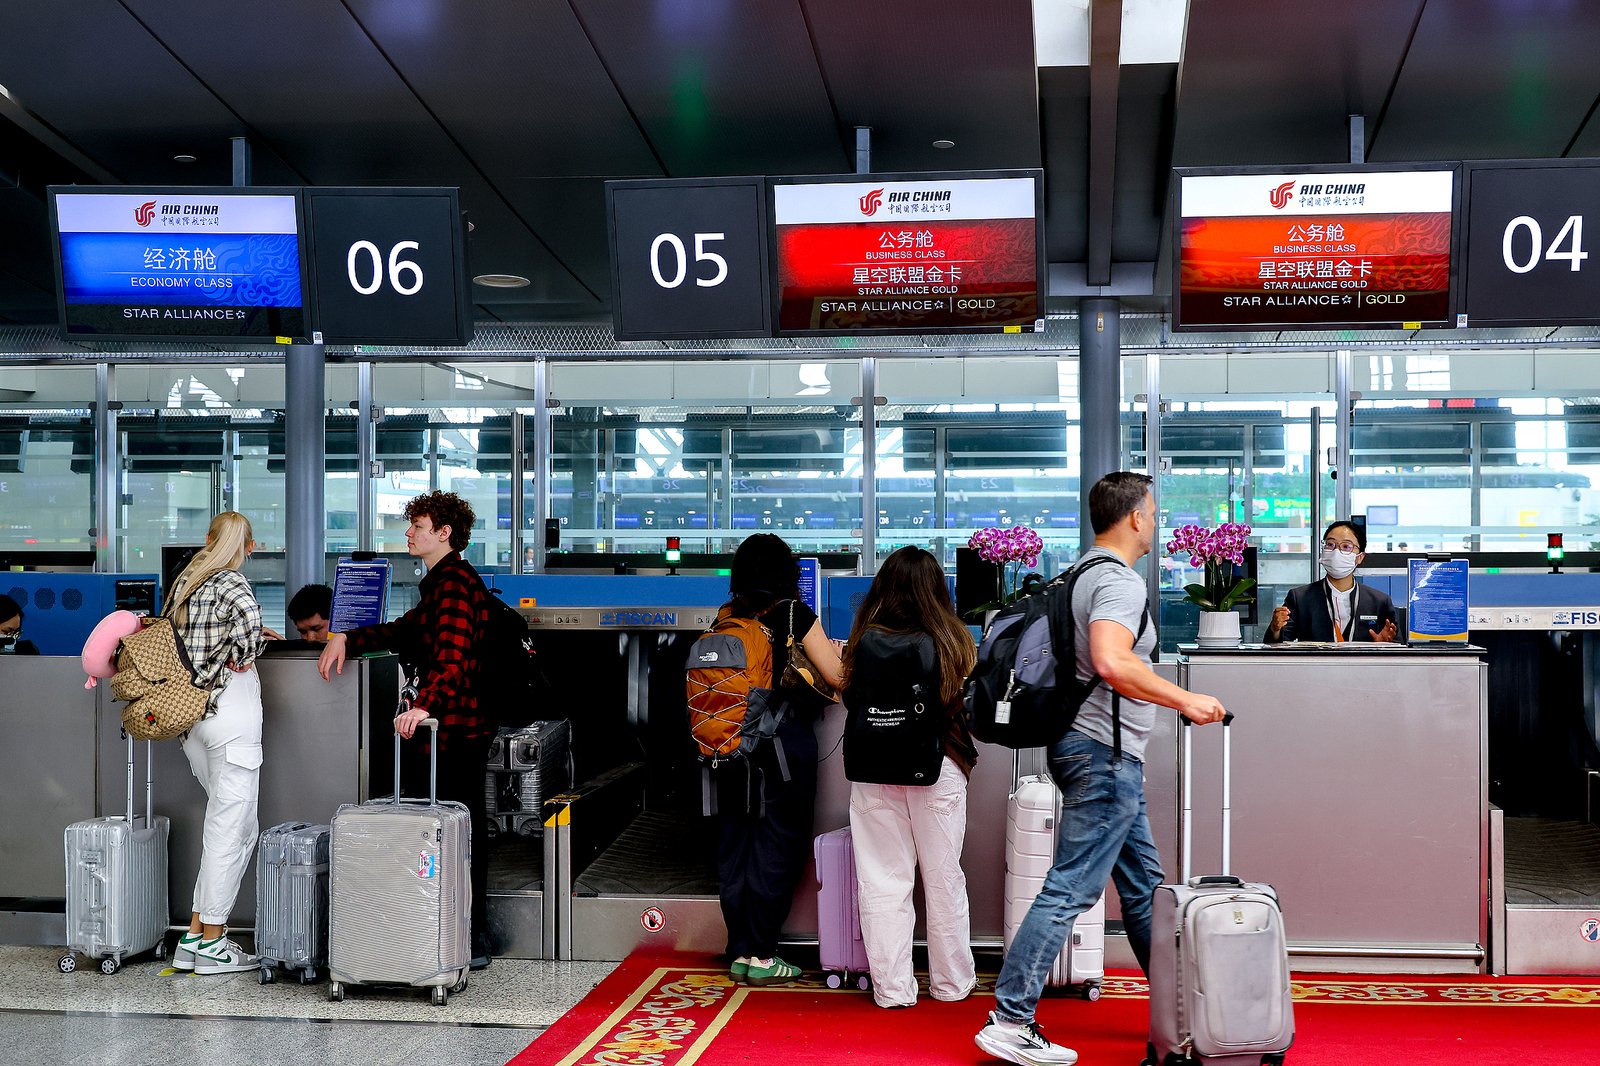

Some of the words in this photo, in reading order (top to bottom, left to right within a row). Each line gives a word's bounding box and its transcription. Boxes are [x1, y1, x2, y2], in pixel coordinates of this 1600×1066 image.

[1300, 184, 1323, 195] AIR
[1325, 183, 1366, 194] CHINA
[888, 191, 910, 202] AIR
[912, 190, 952, 202] CHINA
[161, 204, 181, 215] AIR
[183, 204, 219, 215] CHINA
[1287, 223, 1345, 243] 公务舱
[878, 230, 935, 249] 公务舱
[1502, 215, 1589, 273] 04
[865, 250, 912, 260] BUSINESS
[914, 249, 946, 259] CLASS
[1273, 244, 1321, 254] BUSINESS
[1324, 244, 1356, 253] CLASS
[143, 246, 217, 271] 经济舱
[649, 232, 729, 289] 05
[346, 239, 425, 296] 06
[1258, 259, 1373, 280] 星空联盟金卡
[852, 266, 962, 286] 星空联盟金卡
[130, 276, 192, 289] ECONOMY
[194, 277, 233, 289] CLASS
[1263, 280, 1289, 290] STAR
[1291, 280, 1337, 290] ALLIANCE
[1340, 280, 1368, 290] GOLD
[857, 286, 884, 296] STAR
[885, 286, 930, 295] ALLIANCE
[932, 285, 959, 295] GOLD
[820, 301, 858, 313] STAR
[861, 300, 932, 312] ALLIANCE
[957, 298, 996, 311] GOLD
[1223, 296, 1262, 307] STAR
[1265, 295, 1341, 306] ALLIANCE
[1365, 292, 1406, 305] GOLD
[123, 307, 160, 319] STAR
[162, 308, 235, 320] ALLIANCE
[560, 517, 568, 525] 13
[677, 517, 685, 525] 11
[762, 517, 771, 525] 10
[794, 517, 804, 525] 09
[913, 517, 923, 525] 07
[1001, 517, 1012, 525] 06
[1034, 517, 1045, 525] 05
[615, 612, 676, 625] FISCAN
[1571, 612, 1600, 625] FIS
[868, 707, 905, 716] Champion
